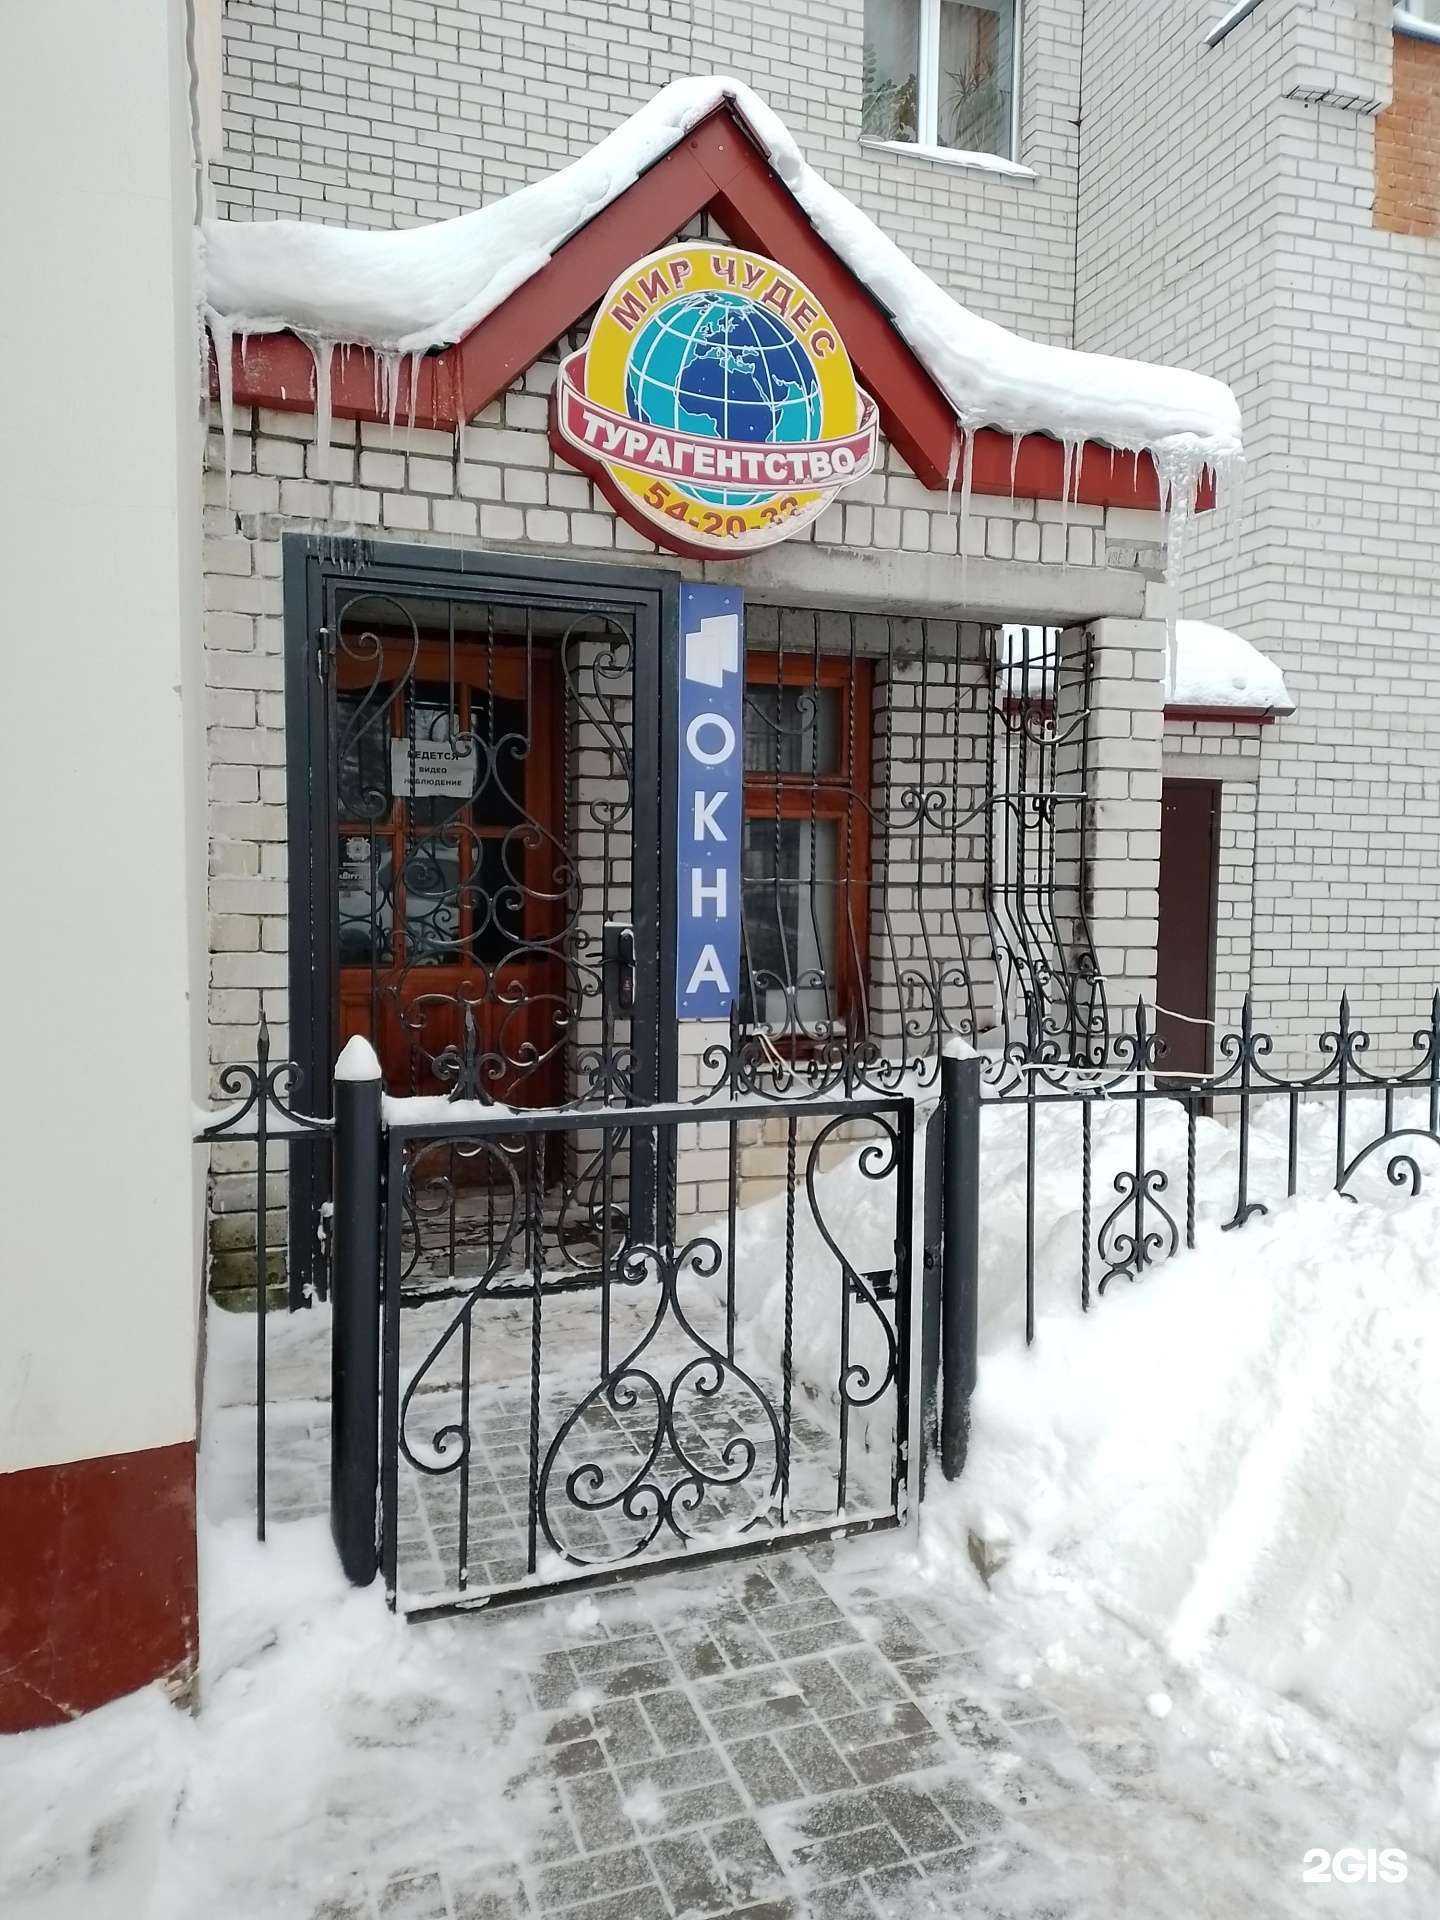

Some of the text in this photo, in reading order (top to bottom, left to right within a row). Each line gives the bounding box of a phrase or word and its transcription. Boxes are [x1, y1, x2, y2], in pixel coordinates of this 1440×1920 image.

[608, 254, 836, 359] МИР ЧУДЕС
[581, 408, 855, 485] ТУРАГЕНТСТВО
[403, 778, 462, 787] НБЛЮДЕНИЕ
[418, 766, 448, 774] ВИДЕО
[685, 712, 736, 994] ОКНА
